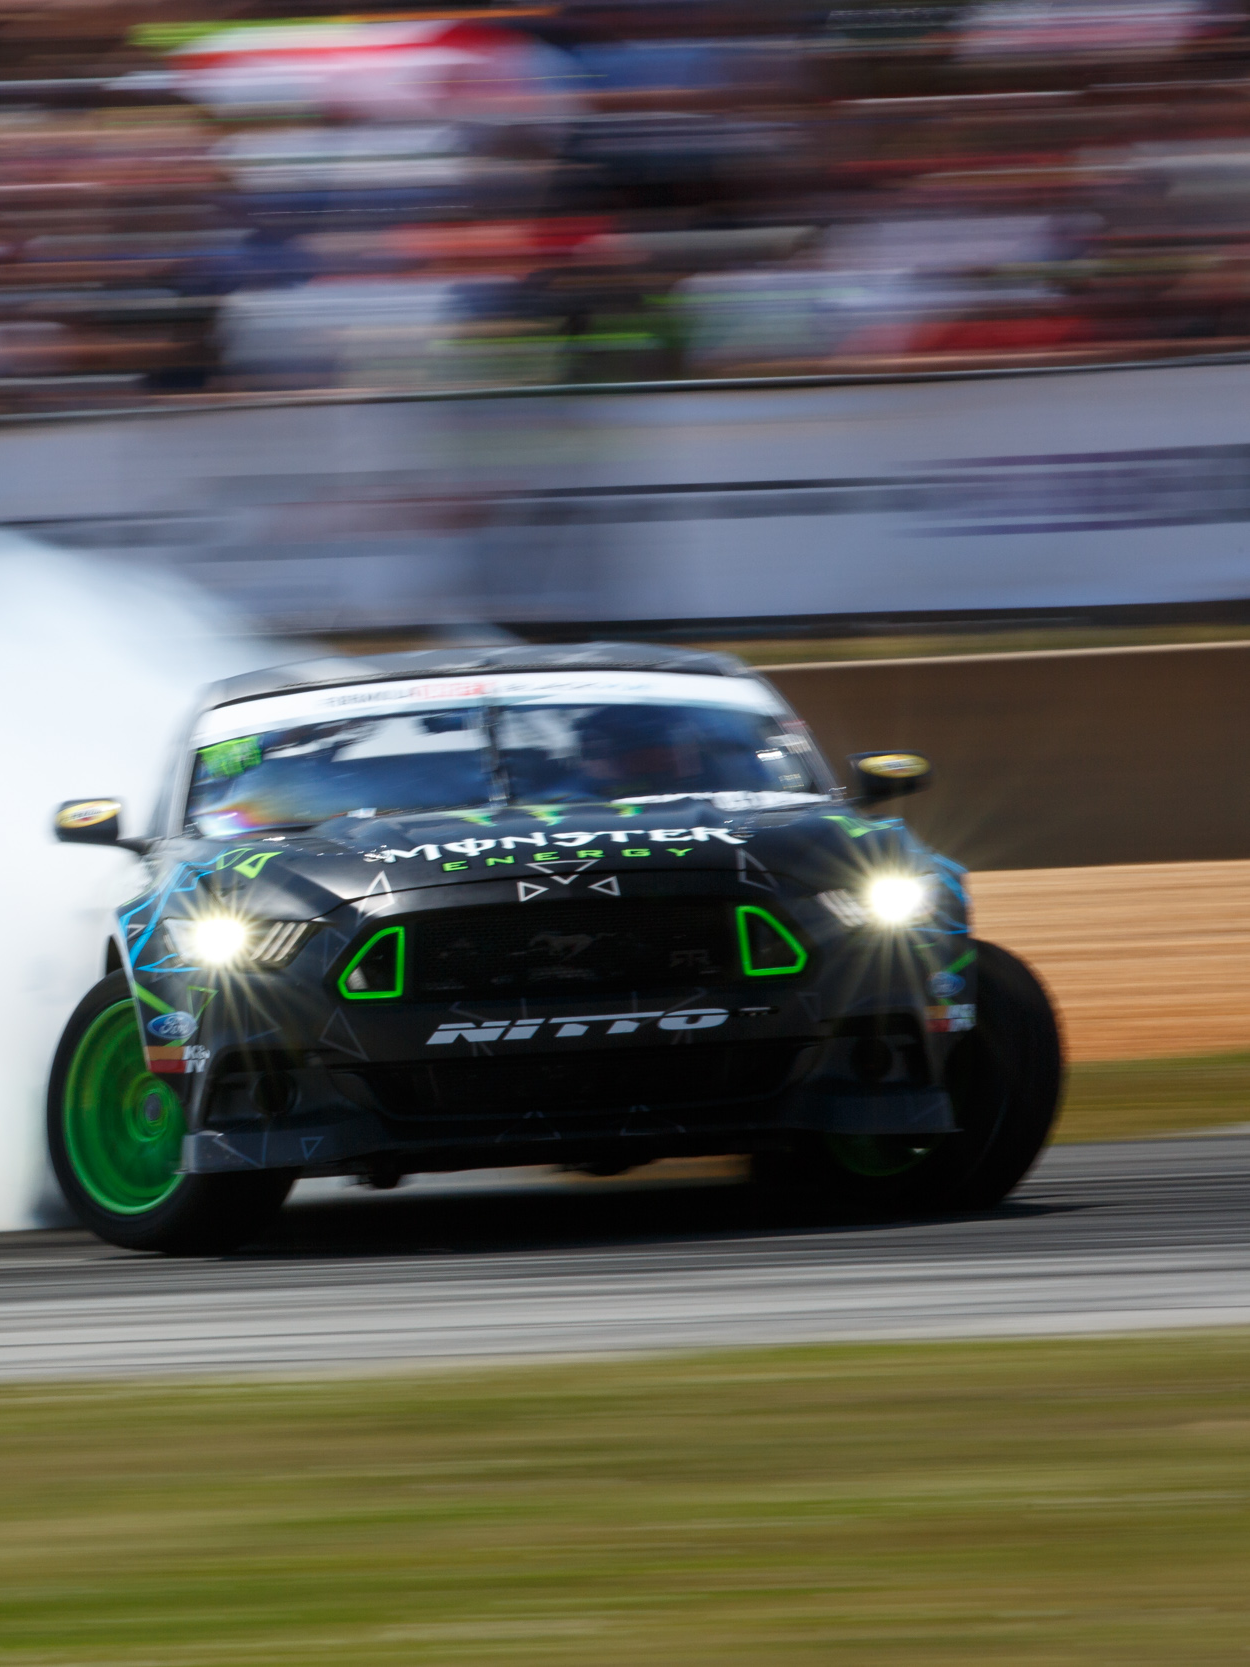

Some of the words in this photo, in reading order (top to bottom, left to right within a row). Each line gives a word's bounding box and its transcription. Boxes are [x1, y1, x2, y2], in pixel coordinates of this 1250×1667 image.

[378, 826, 749, 863] MONSTER
[442, 847, 693, 873] ENERGY
[425, 1008, 729, 1045] NITTO
